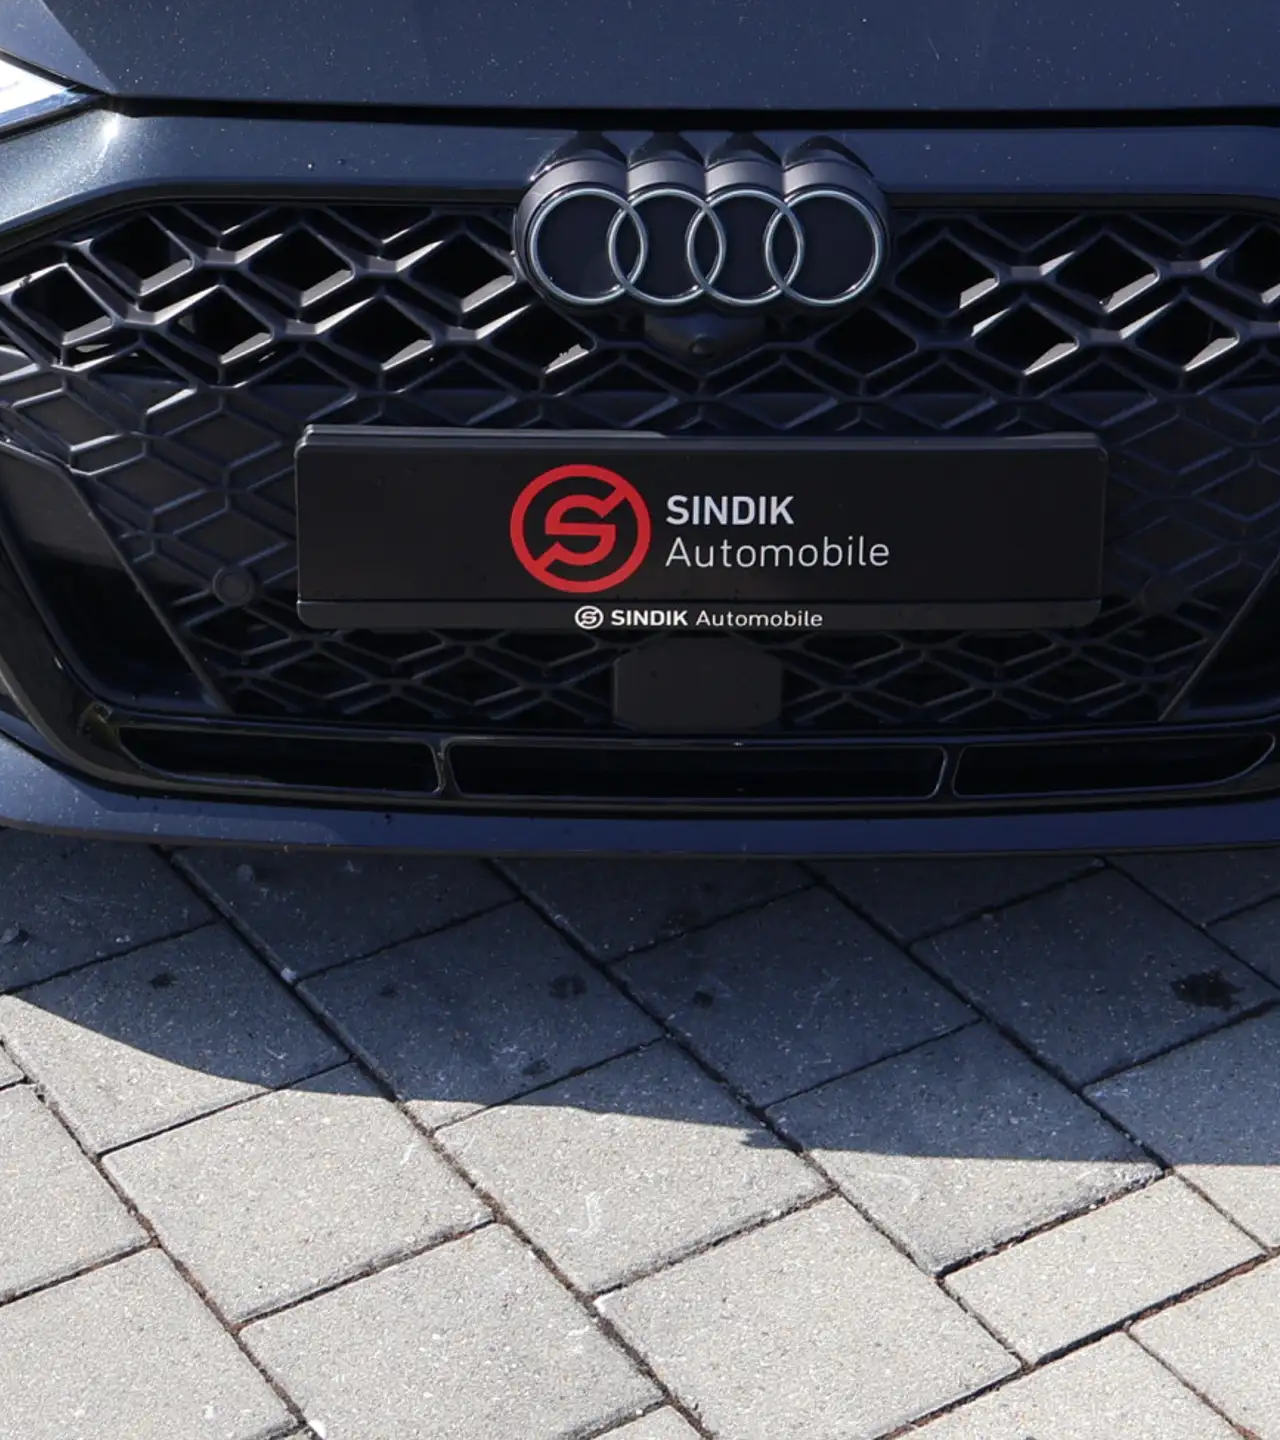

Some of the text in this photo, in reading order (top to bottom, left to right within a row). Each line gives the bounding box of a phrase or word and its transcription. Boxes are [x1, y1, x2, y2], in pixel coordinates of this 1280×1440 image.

[665, 494, 795, 526] SINDIK
[664, 535, 891, 568] Automobile
[610, 609, 689, 627] SINDIK
[695, 609, 824, 628] Automobile
